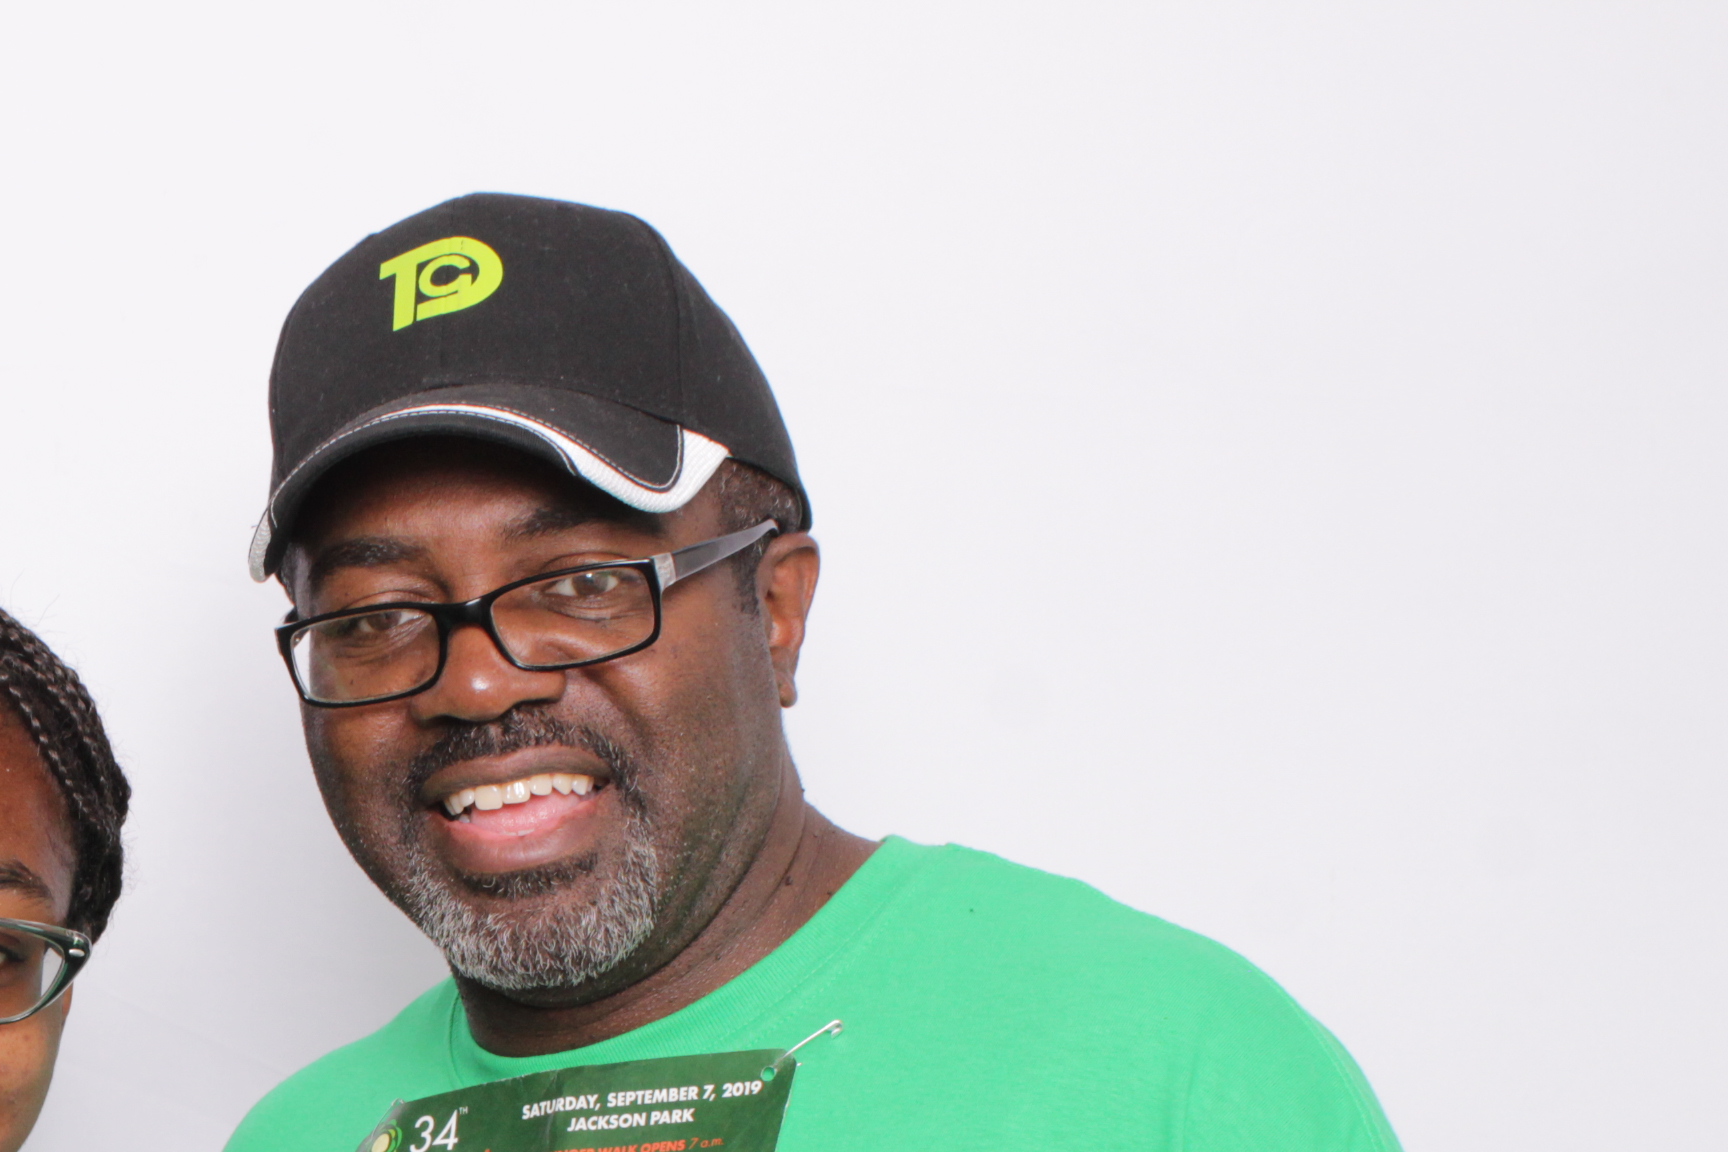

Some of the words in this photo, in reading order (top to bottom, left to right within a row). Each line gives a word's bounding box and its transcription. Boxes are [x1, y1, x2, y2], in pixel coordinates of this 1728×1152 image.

[522, 1094, 602, 1120] SATURDAY,
[607, 1085, 699, 1108] SEPTEMBER
[702, 1084, 716, 1102] 7,
[722, 1080, 763, 1098] 2019
[567, 1112, 647, 1132] JACKSON
[650, 1108, 696, 1127] PARK
[688, 1137, 699, 1150] 7
